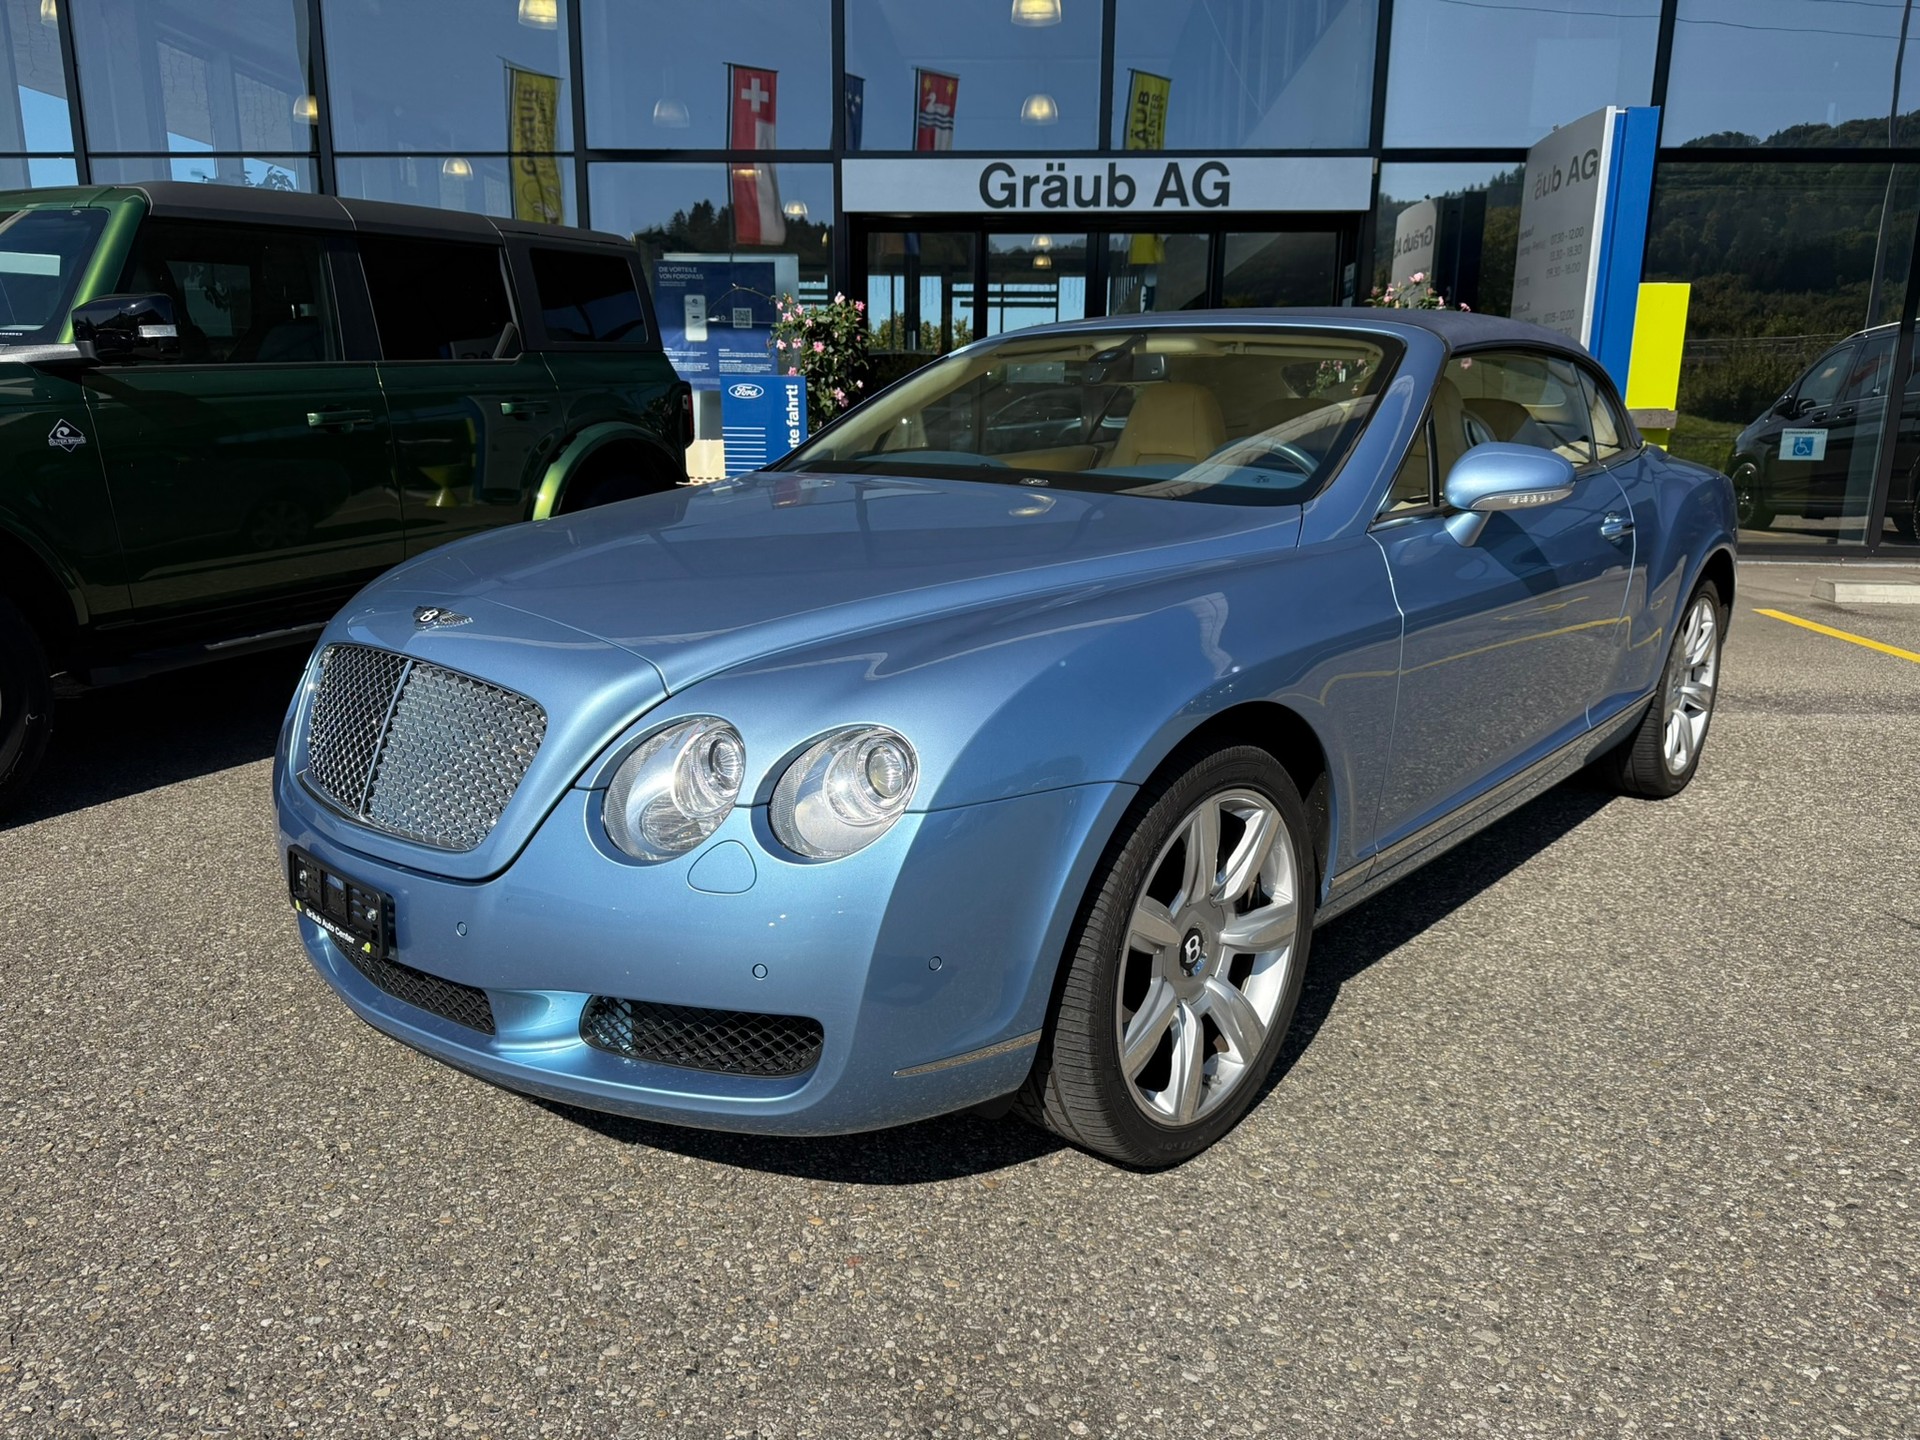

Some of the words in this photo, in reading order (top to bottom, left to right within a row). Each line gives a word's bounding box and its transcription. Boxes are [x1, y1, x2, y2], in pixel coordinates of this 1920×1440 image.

[1130, 90, 1149, 146] ÄUB
[979, 161, 1137, 209] Gräub
[1153, 161, 1231, 208] AG
[1534, 164, 1562, 200] äub
[1566, 148, 1599, 188] AG
[734, 386, 758, 397] Ford
[785, 384, 800, 427] fahrt!
[322, 919, 335, 933] Auto
[335, 926, 356, 945] Center
[1184, 934, 1201, 964] B
